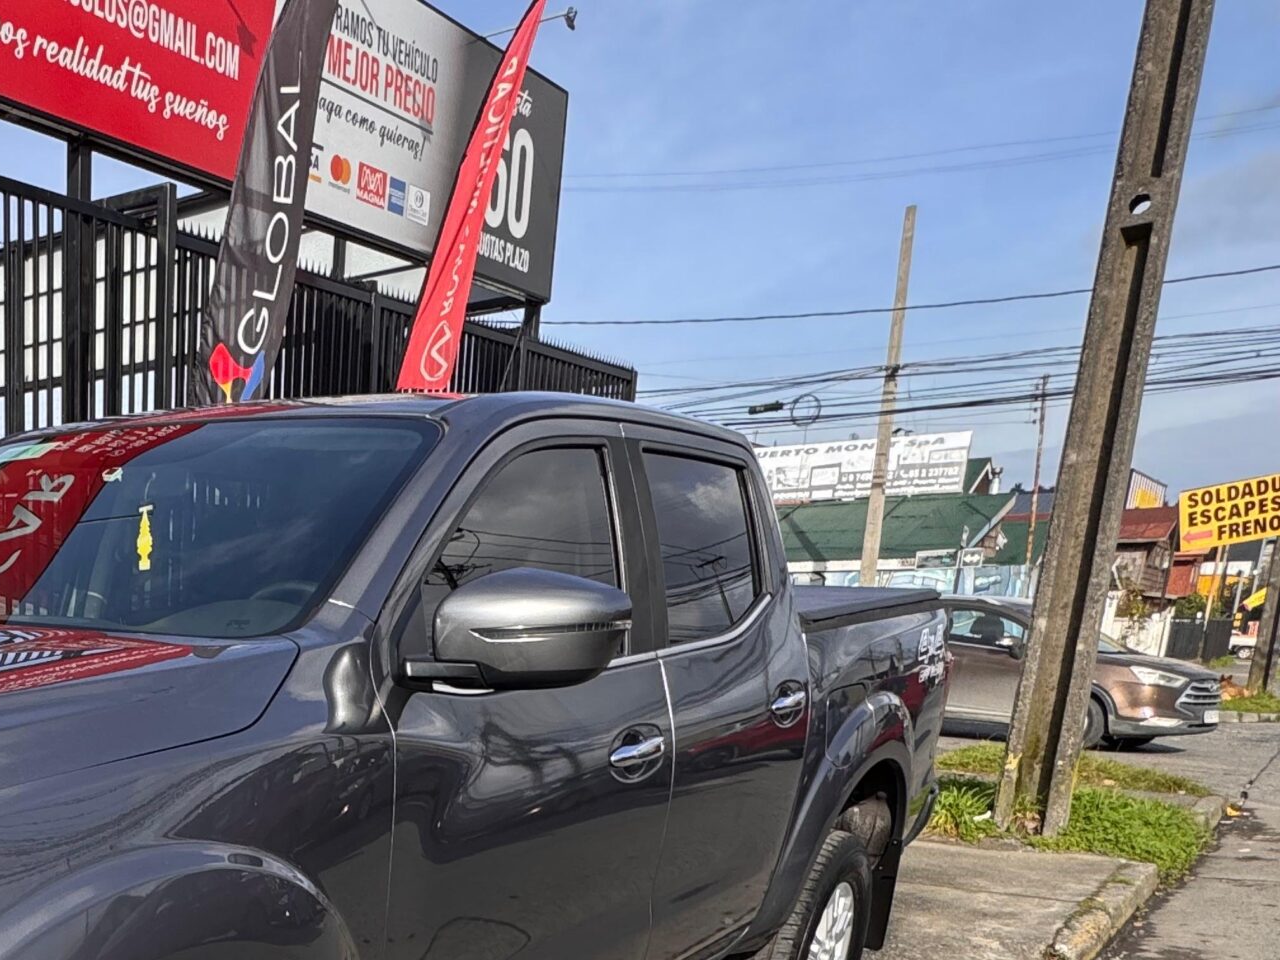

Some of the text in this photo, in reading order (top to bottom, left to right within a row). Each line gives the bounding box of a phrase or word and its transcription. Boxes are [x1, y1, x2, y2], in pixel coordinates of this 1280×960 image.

[334, 3, 374, 49] RAMOS
[376, 25, 389, 56] TU
[33, 36, 128, 92] realidad
[124, 56, 162, 113] tus
[163, 91, 229, 140] sueños
[327, 34, 436, 126] MEJOR PRECIO
[511, 89, 532, 118] sta
[319, 96, 426, 161] aga como quieras!
[237, 50, 303, 355] GLOBAL
[476, 230, 531, 274] UOTAS PLAZO
[756, 446, 819, 459] UERTO
[825, 438, 899, 455] MONT
[1187, 496, 1280, 527] ESCAPES
